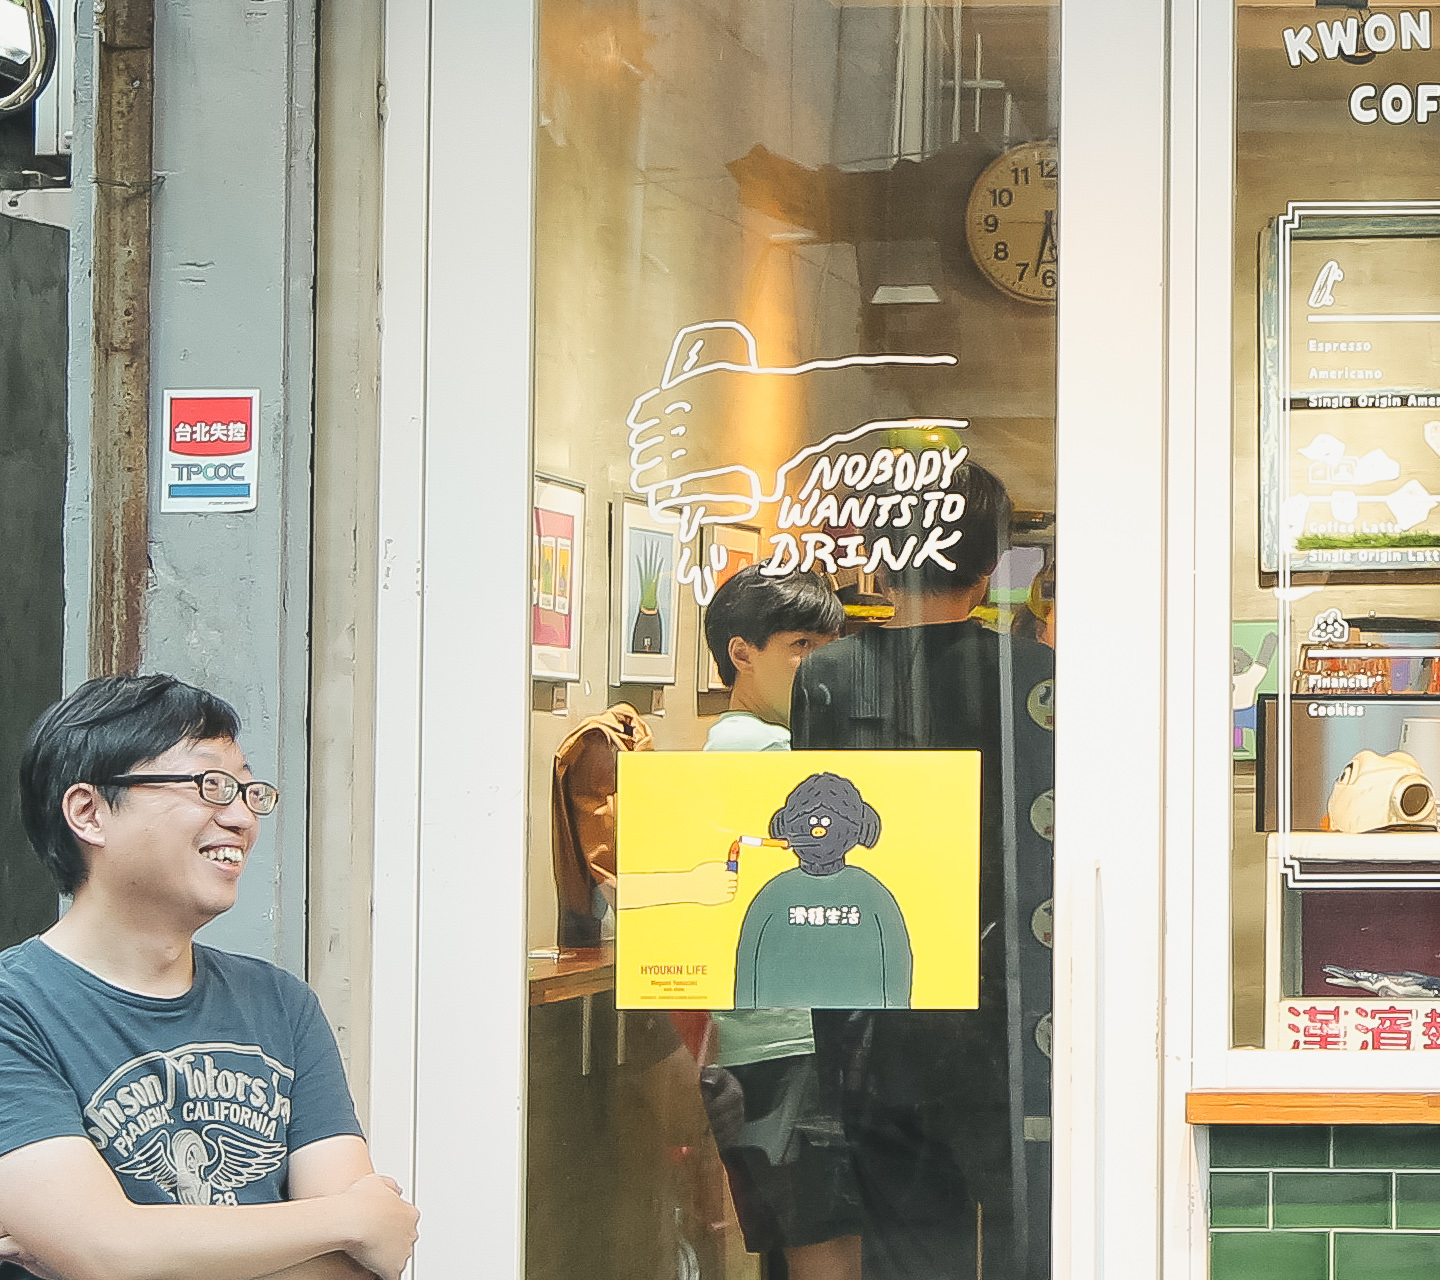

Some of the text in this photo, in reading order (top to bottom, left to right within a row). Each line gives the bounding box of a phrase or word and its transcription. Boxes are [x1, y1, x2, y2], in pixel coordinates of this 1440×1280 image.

[1282, 10, 1432, 67] KWON
[1011, 167, 1030, 185] 11
[990, 188, 1013, 207] 10
[983, 214, 999, 233] 9
[994, 241, 1009, 261] 8
[1016, 262, 1029, 282] 7
[1042, 270, 1056, 288] 6
[1308, 339, 1372, 353] Espresso
[1308, 367, 1383, 380] Americano
[1308, 394, 1352, 408] Single
[1357, 394, 1402, 408] Origin
[174, 422, 247, 443] 台北失控
[798, 446, 969, 501] NOBODY
[777, 488, 966, 529] WANTS TO
[1309, 521, 1356, 534] Coffee
[759, 525, 963, 577] DRINK
[1309, 550, 1352, 564] Single
[1359, 550, 1402, 564] Origin
[1307, 702, 1365, 717] Cookies
[640, 964, 708, 976] HYOUKIN LIFE
[181, 1100, 278, 1141] CALIFORNIA
